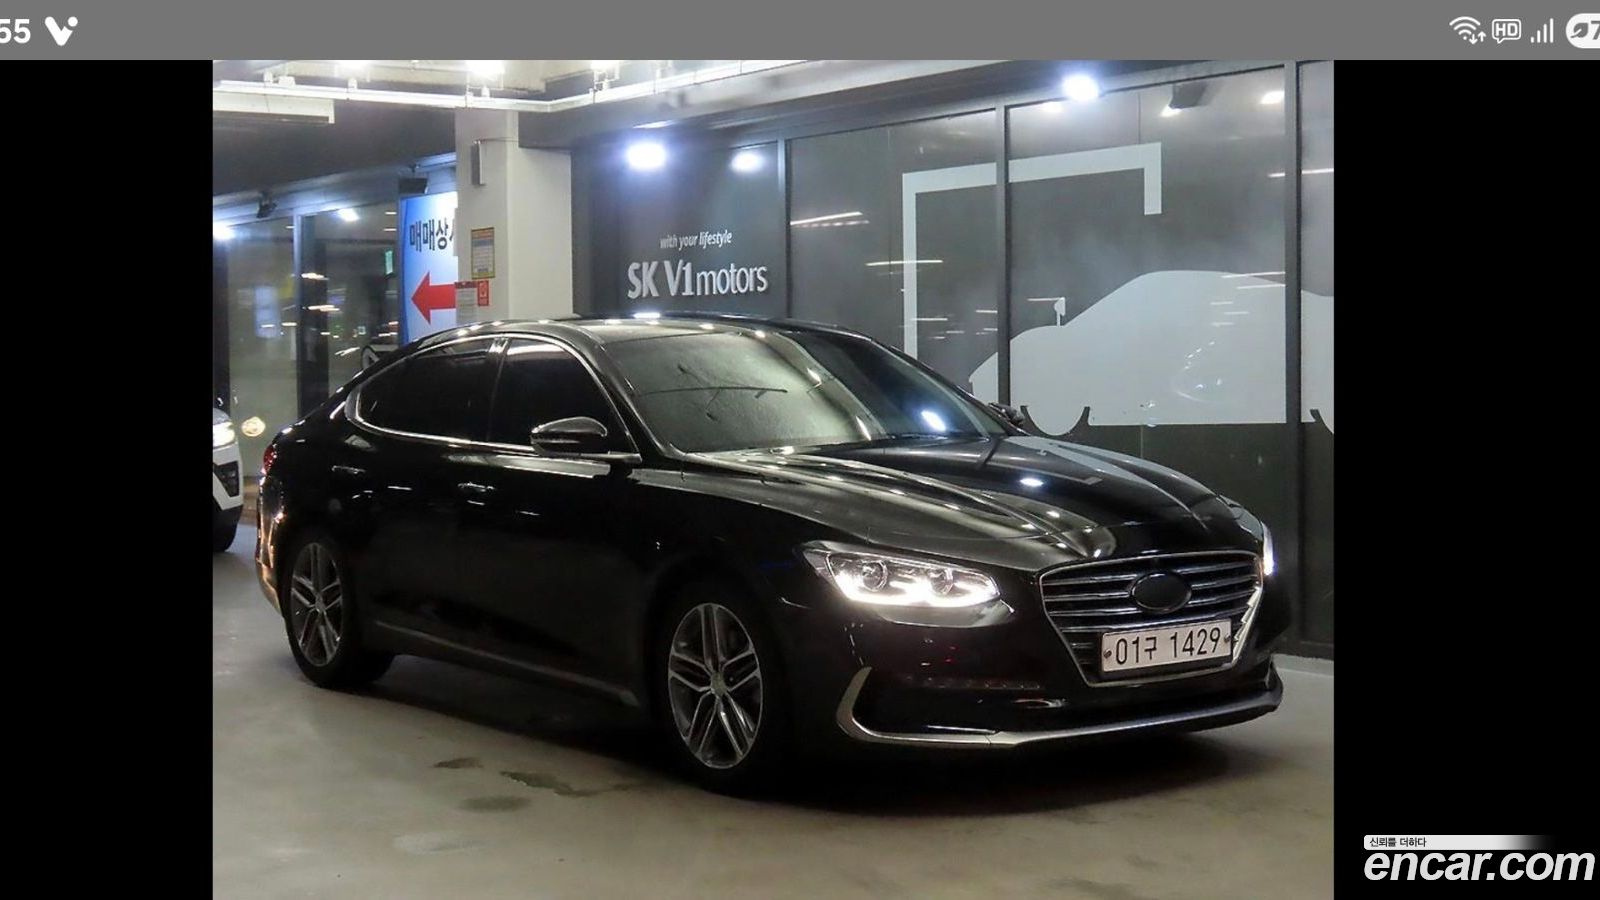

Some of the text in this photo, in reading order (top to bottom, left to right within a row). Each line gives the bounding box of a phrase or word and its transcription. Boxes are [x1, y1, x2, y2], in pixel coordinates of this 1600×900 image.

[409, 218, 455, 252] 매매상
[660, 229, 732, 251] with your lifestyle
[627, 260, 660, 299] SK
[1115, 627, 1221, 665] 01구 1429
